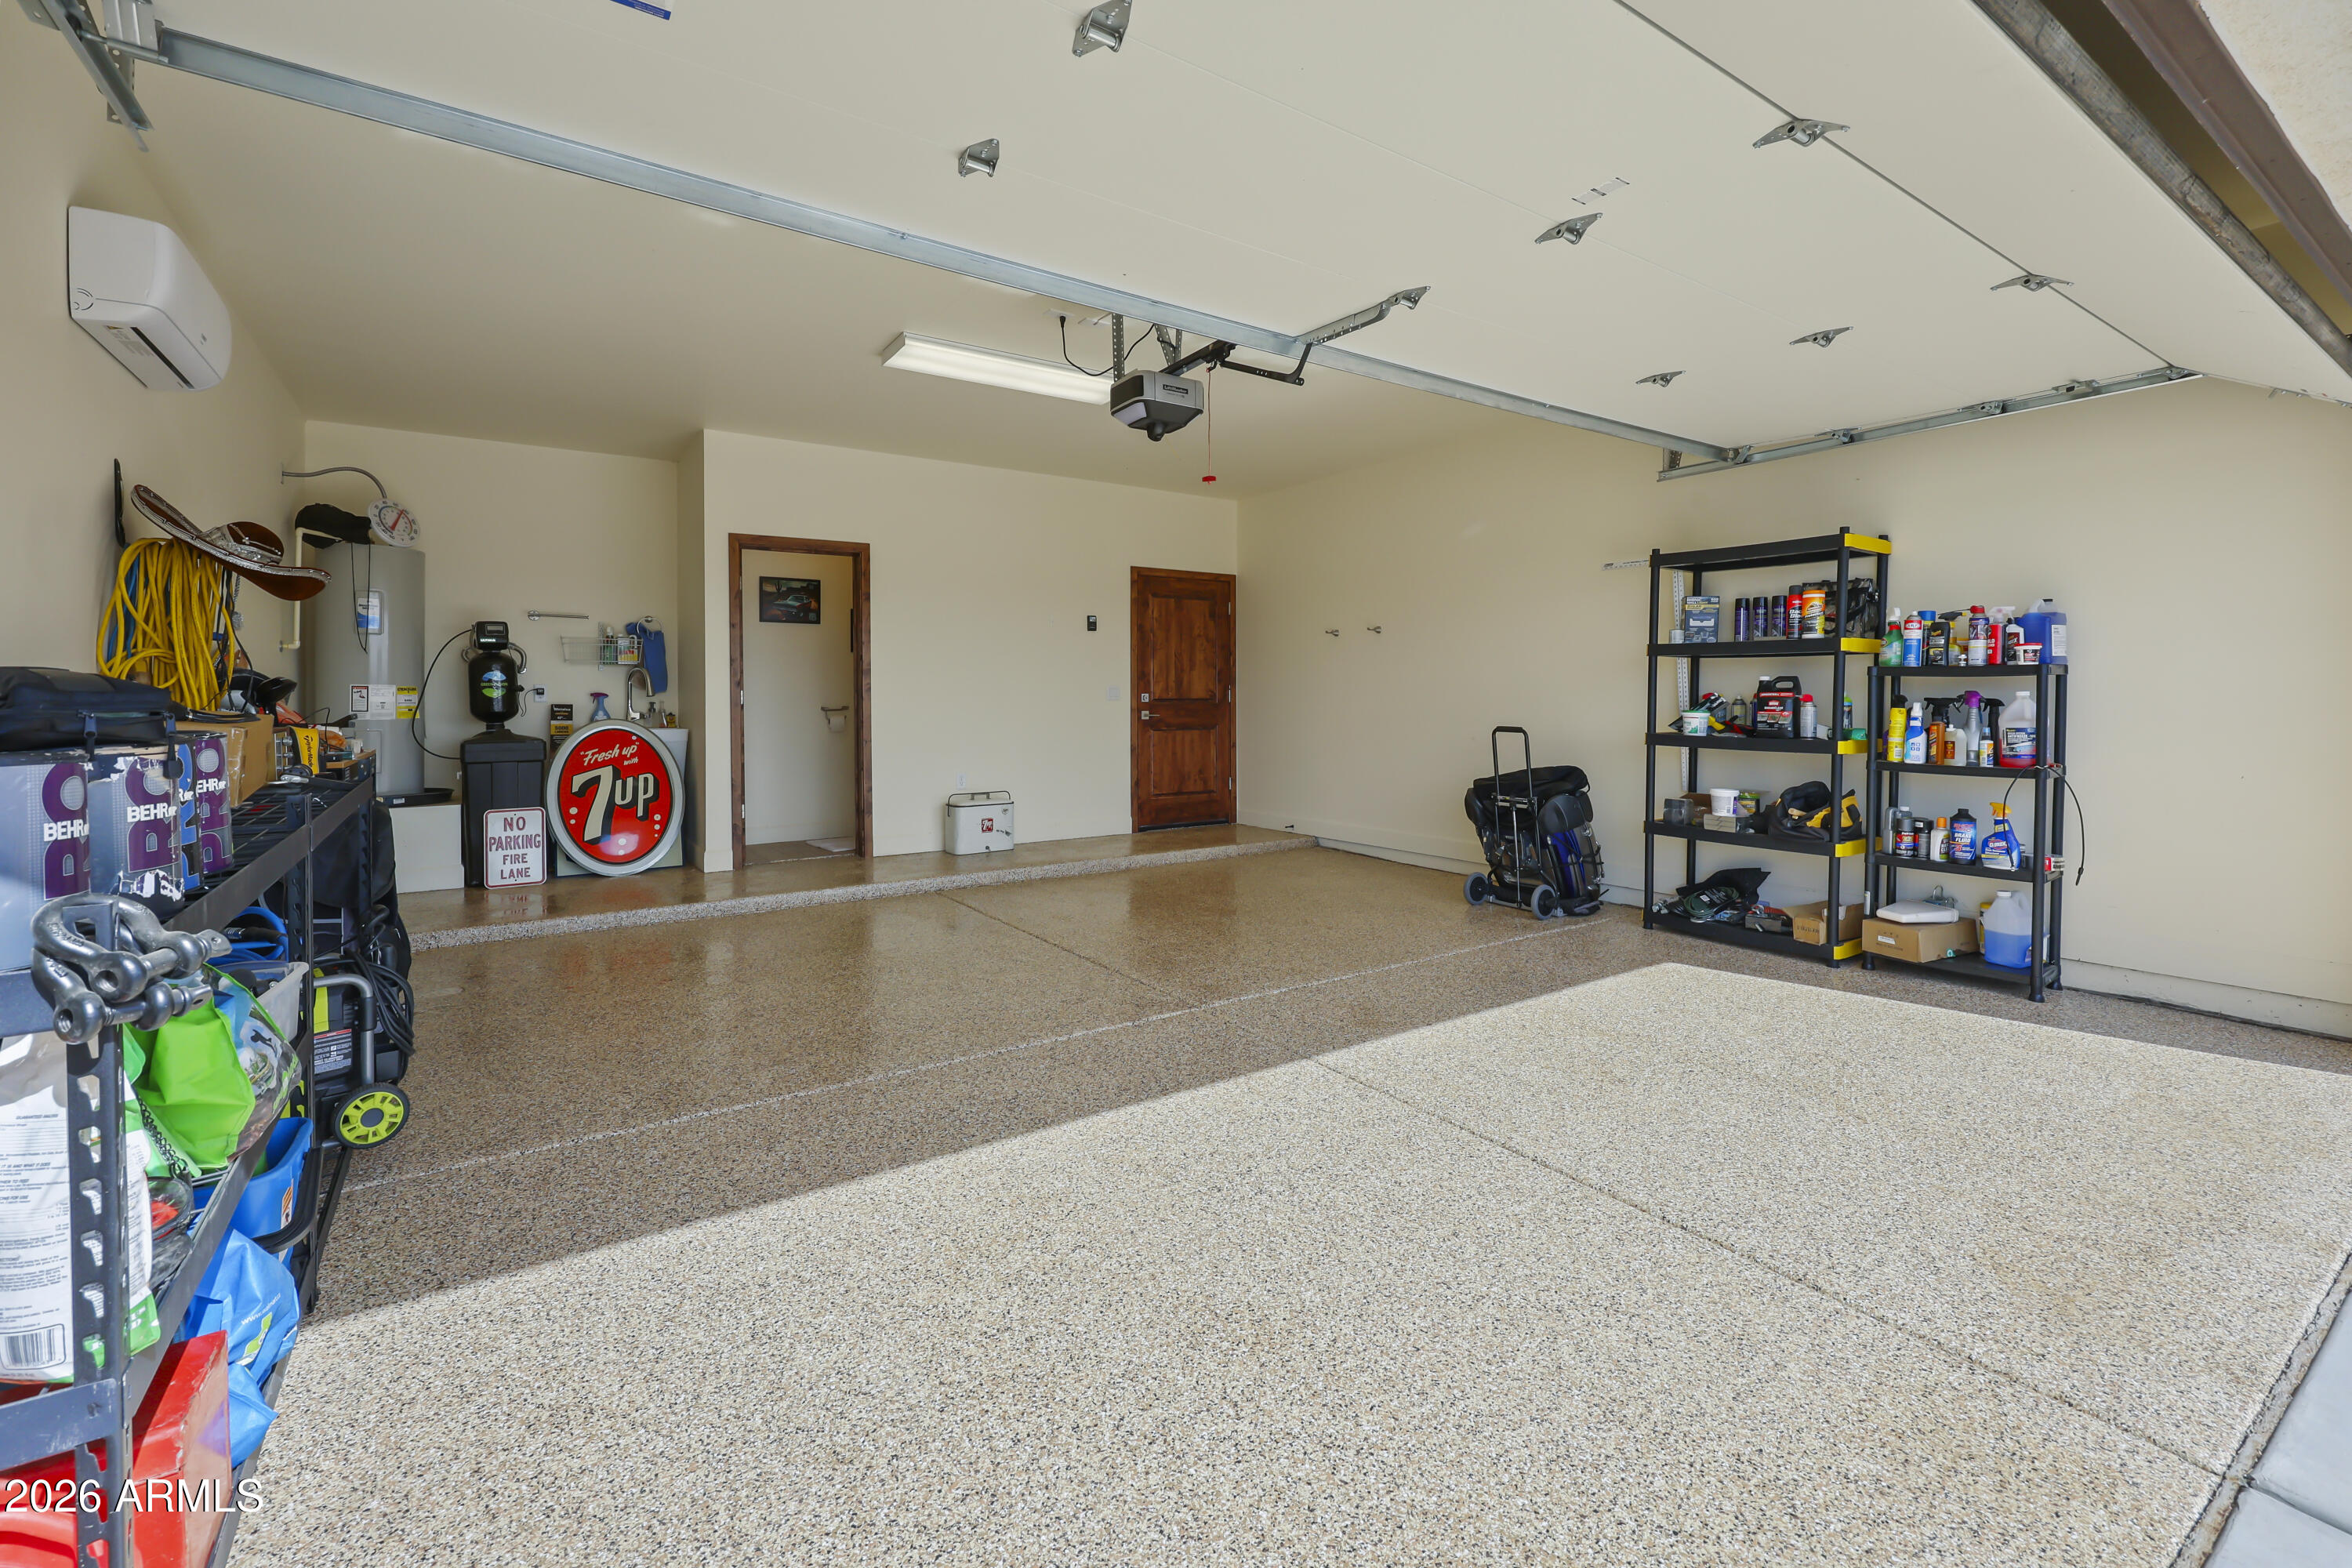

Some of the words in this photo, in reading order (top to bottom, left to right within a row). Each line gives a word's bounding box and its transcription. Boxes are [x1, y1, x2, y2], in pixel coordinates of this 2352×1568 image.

[623, 756, 639, 766] with
[196, 778, 220, 795] EHR
[126, 802, 169, 823] BEHR
[43, 818, 85, 842] BEHR
[503, 816, 526, 832] NO
[488, 833, 542, 852] PARKING
[503, 853, 528, 866] FIRE
[500, 866, 531, 880] LANE
